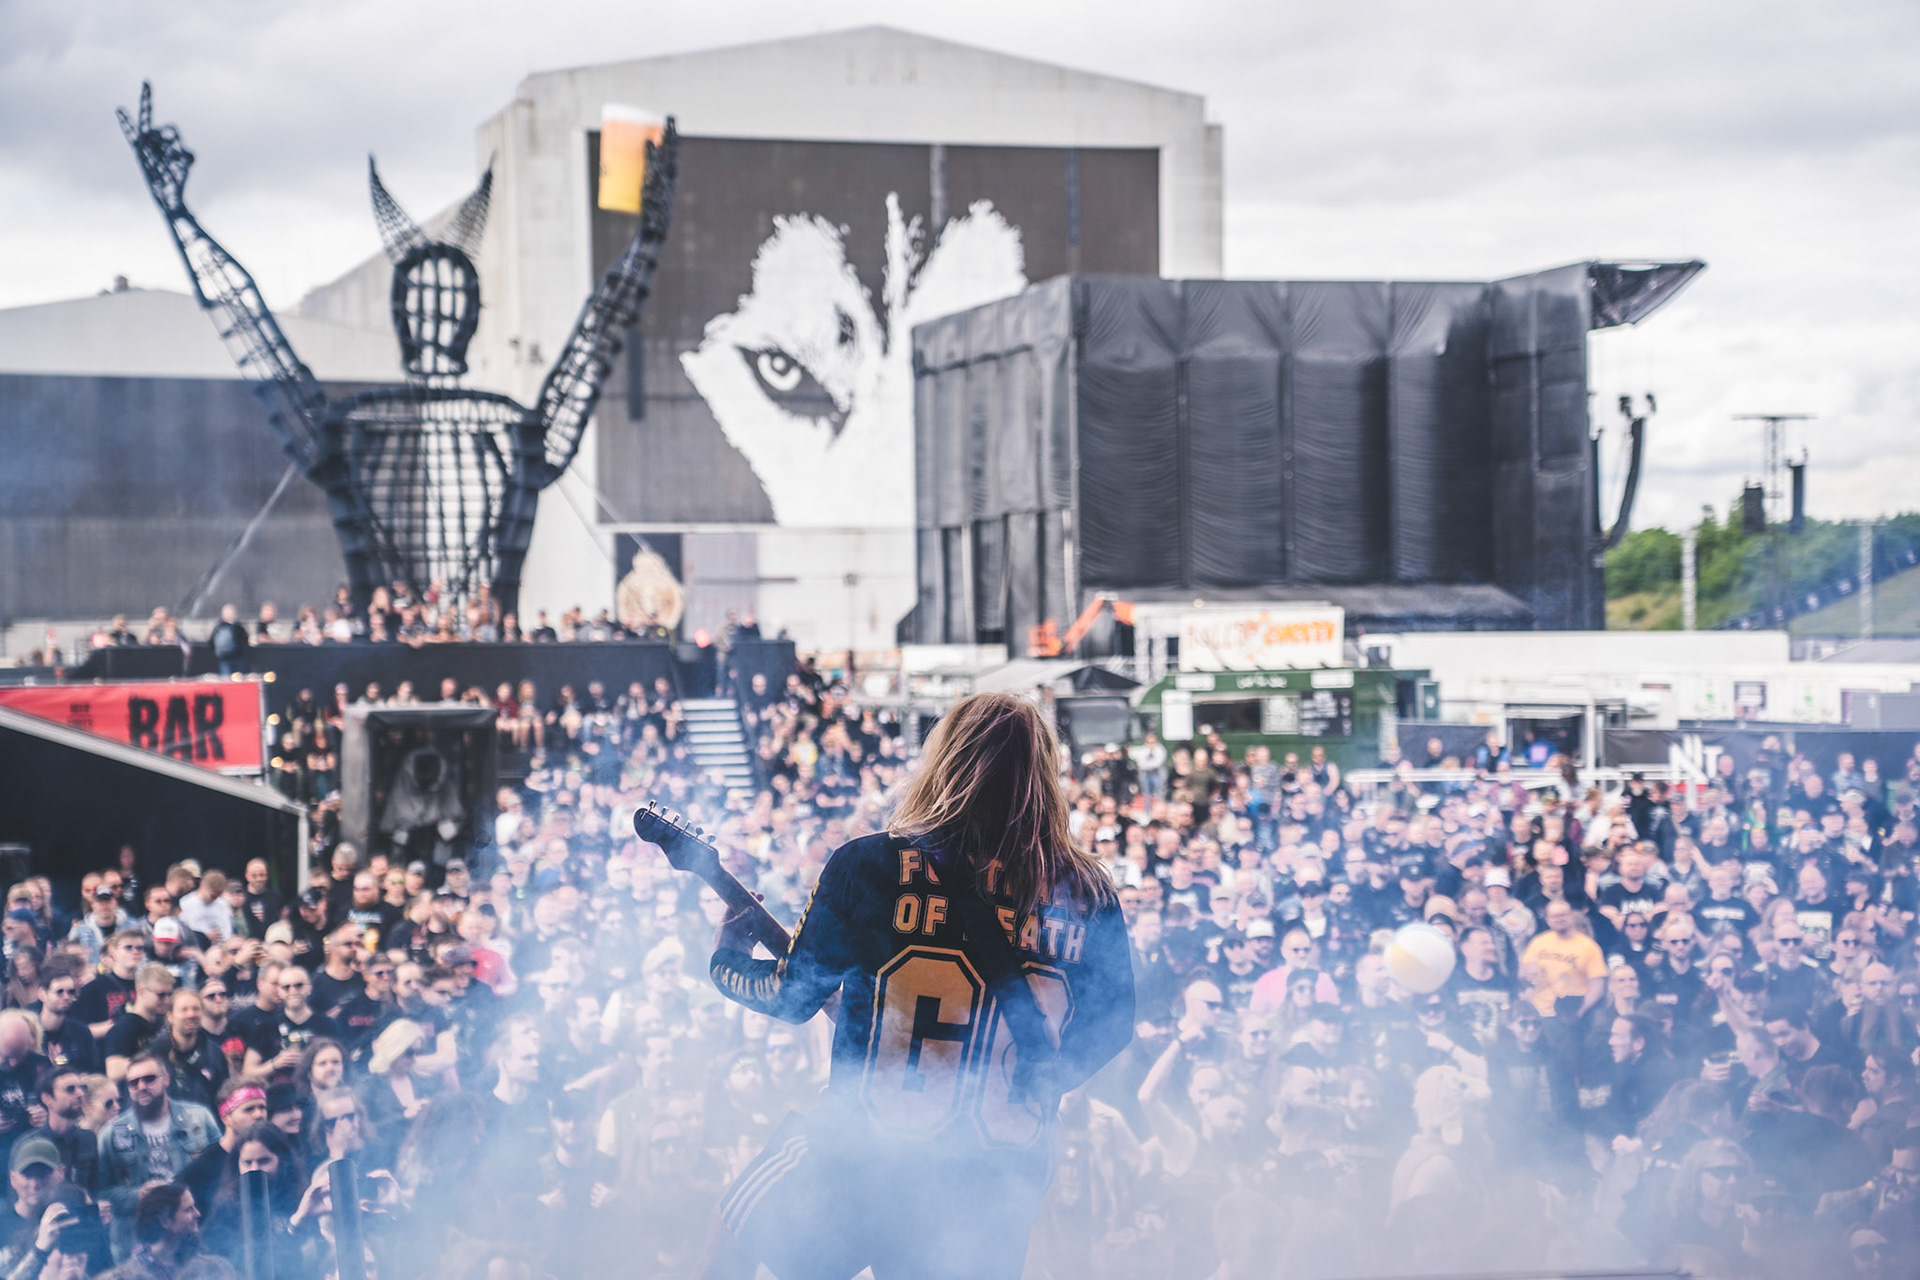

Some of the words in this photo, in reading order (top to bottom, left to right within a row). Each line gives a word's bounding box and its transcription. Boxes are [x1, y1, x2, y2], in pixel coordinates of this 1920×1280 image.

[127, 690, 225, 760] BAR
[892, 892, 949, 936] OF
[963, 905, 1087, 964] EATH
